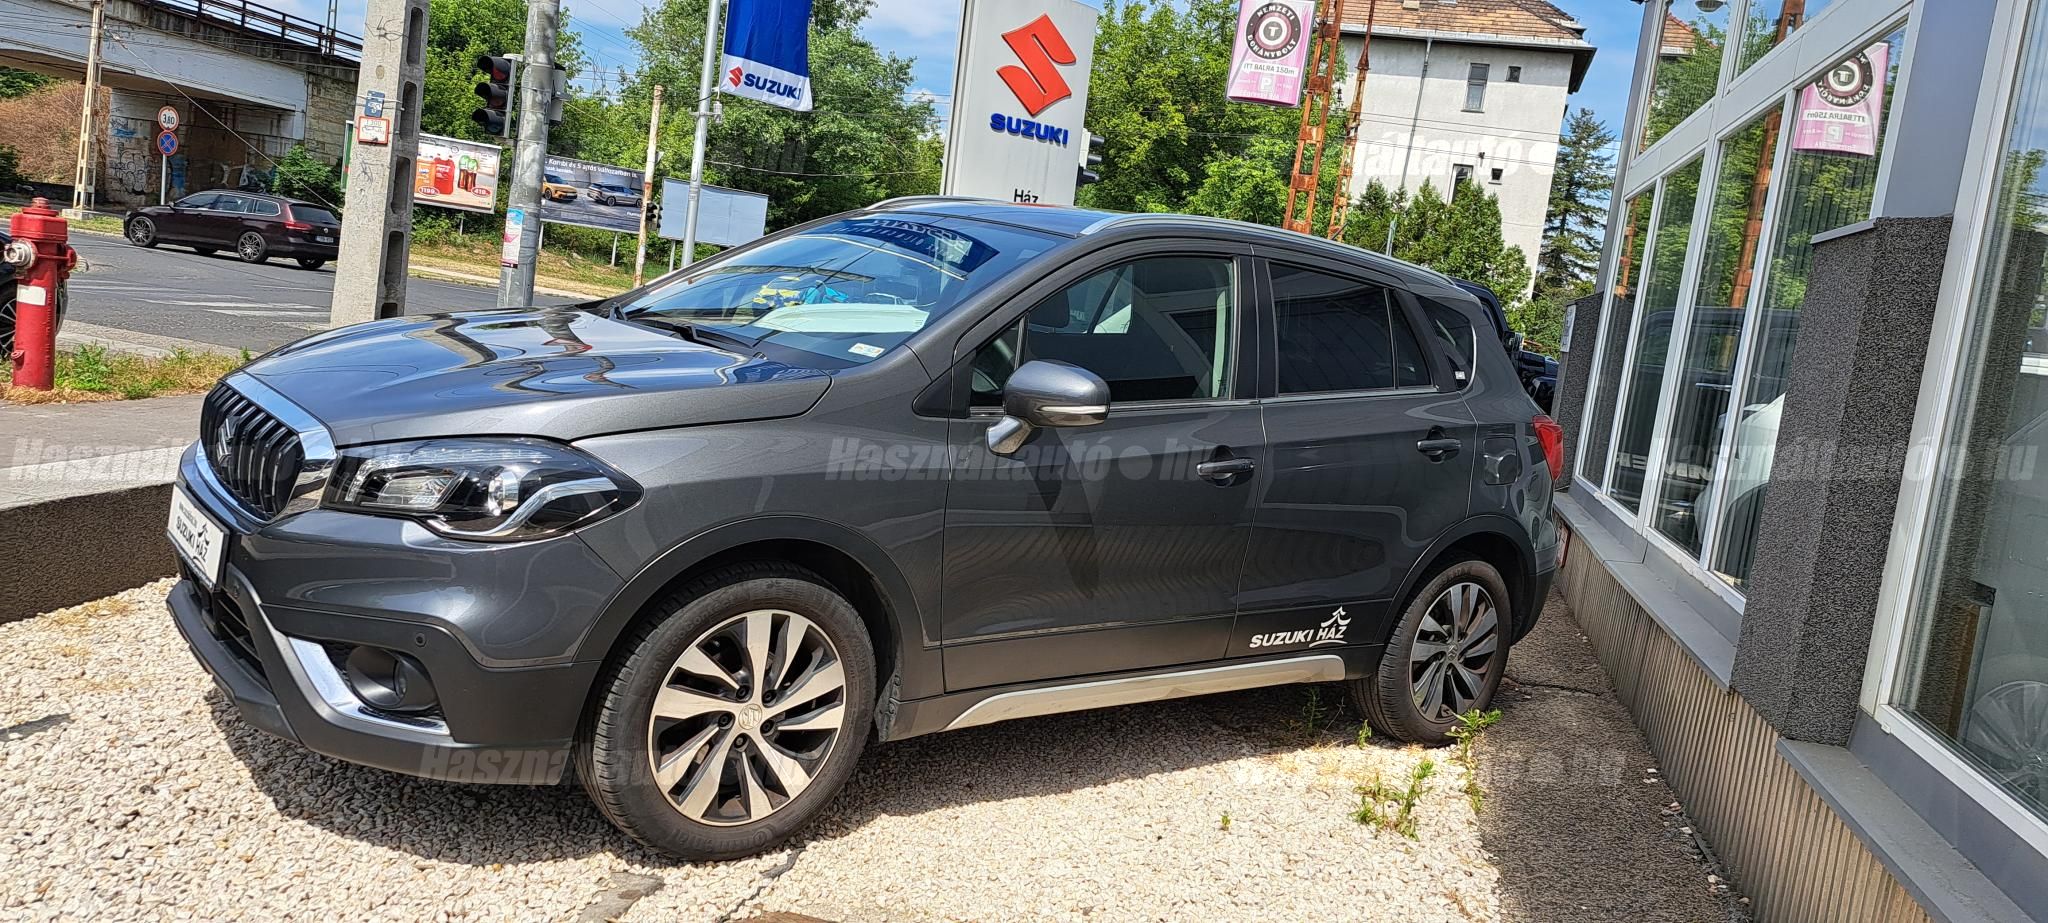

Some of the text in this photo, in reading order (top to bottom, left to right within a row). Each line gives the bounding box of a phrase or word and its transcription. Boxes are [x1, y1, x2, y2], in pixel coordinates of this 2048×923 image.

[1256, 5, 1295, 20] NEMZETI
[1268, 26, 1279, 37] T
[1247, 34, 1296, 58] DOHÁNYBOLT
[1254, 63, 1275, 73] BALRA
[1276, 66, 1295, 75] 150m
[743, 73, 801, 100] SUZUKI
[990, 113, 1068, 145] SUZUKI
[175, 515, 196, 549] SUZUKI
[1249, 623, 1347, 648] SUZUKI HÁZ
